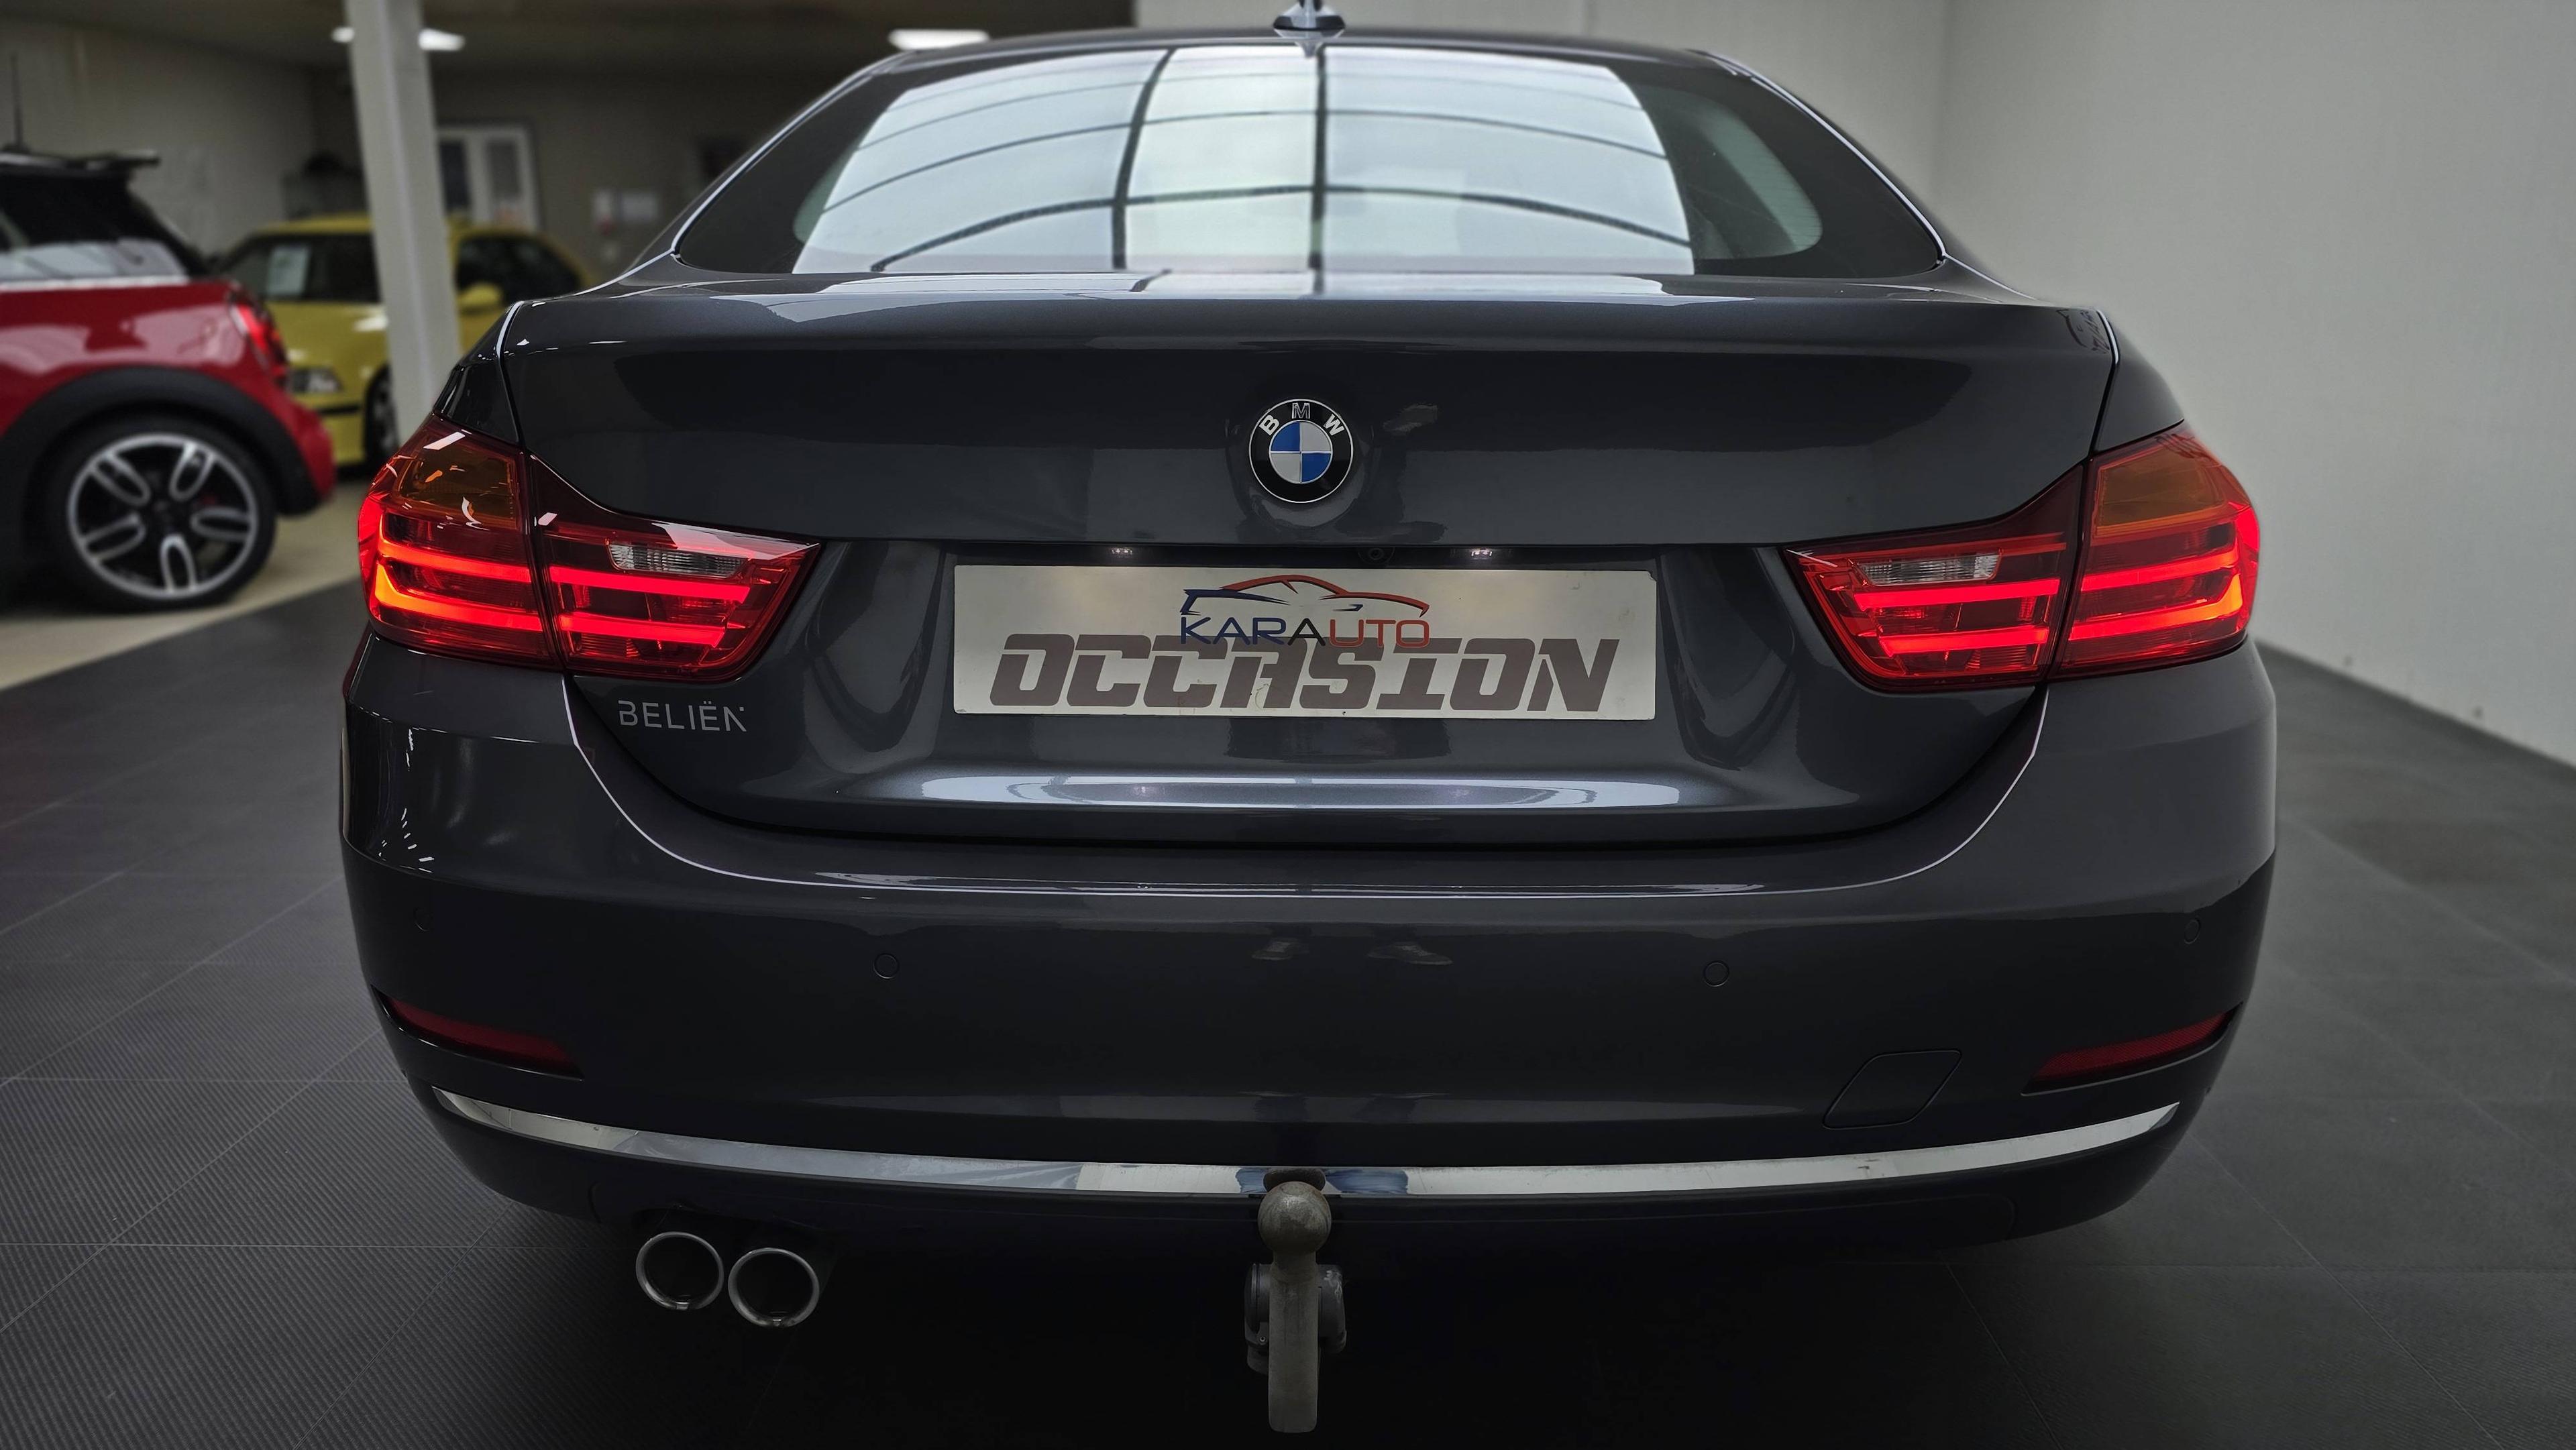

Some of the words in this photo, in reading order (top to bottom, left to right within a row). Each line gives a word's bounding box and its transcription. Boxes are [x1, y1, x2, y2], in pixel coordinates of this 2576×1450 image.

[1258, 402, 1344, 436] BMW
[1179, 616, 1430, 647] KARAUTO
[989, 634, 1619, 712] OCCASION
